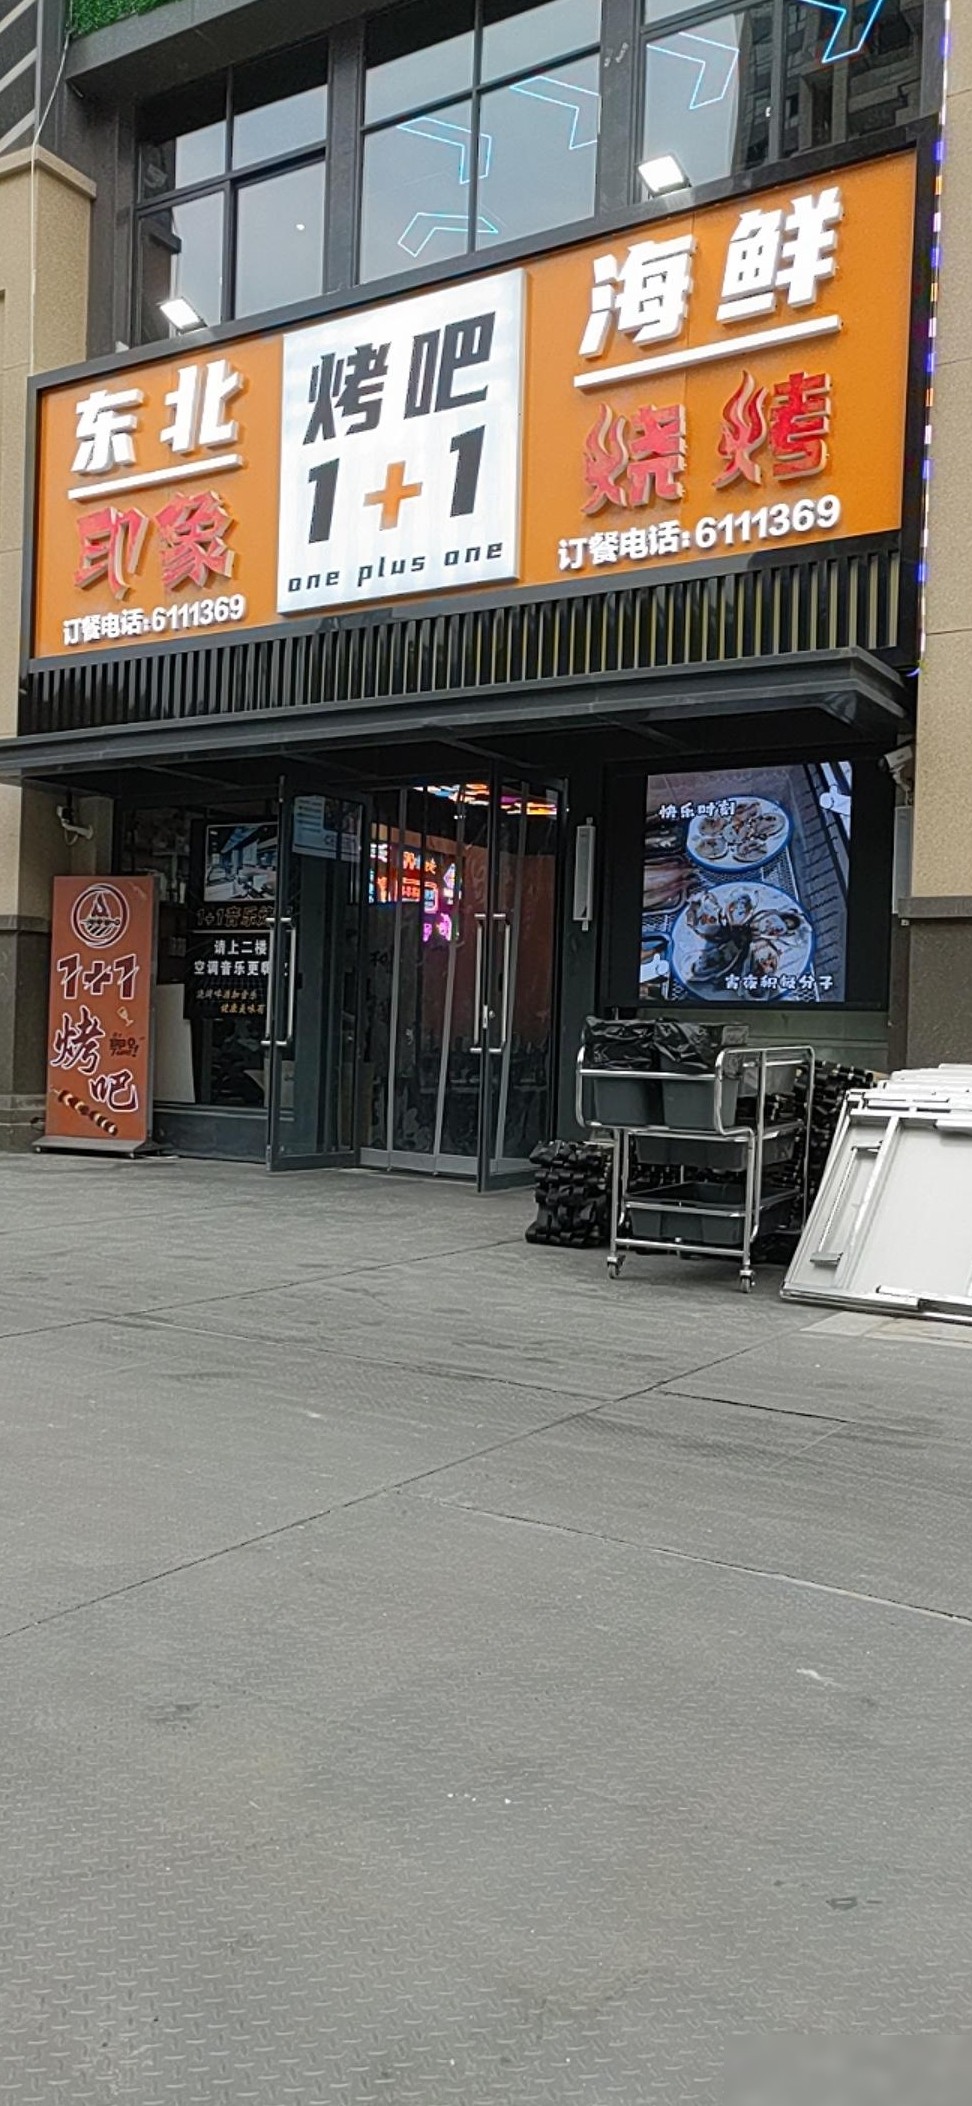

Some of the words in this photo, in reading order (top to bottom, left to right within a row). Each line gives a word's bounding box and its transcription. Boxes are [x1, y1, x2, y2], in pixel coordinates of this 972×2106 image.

[579, 186, 844, 357] 海鲜
[71, 360, 243, 474] 东北
[302, 311, 496, 445] 烤吧
[308, 425, 486, 544] 1+1
[581, 370, 832, 515] 烧烤
[74, 490, 236, 600] 印象
[287, 570, 341, 593] one
[356, 555, 426, 588] plus
[443, 542, 503, 567] one
[659, 800, 736, 820] 快乐时刻
[57, 953, 140, 1000] 1+1
[214, 938, 267, 956] 请上二楼
[725, 974, 834, 991] 宵夜积极分子
